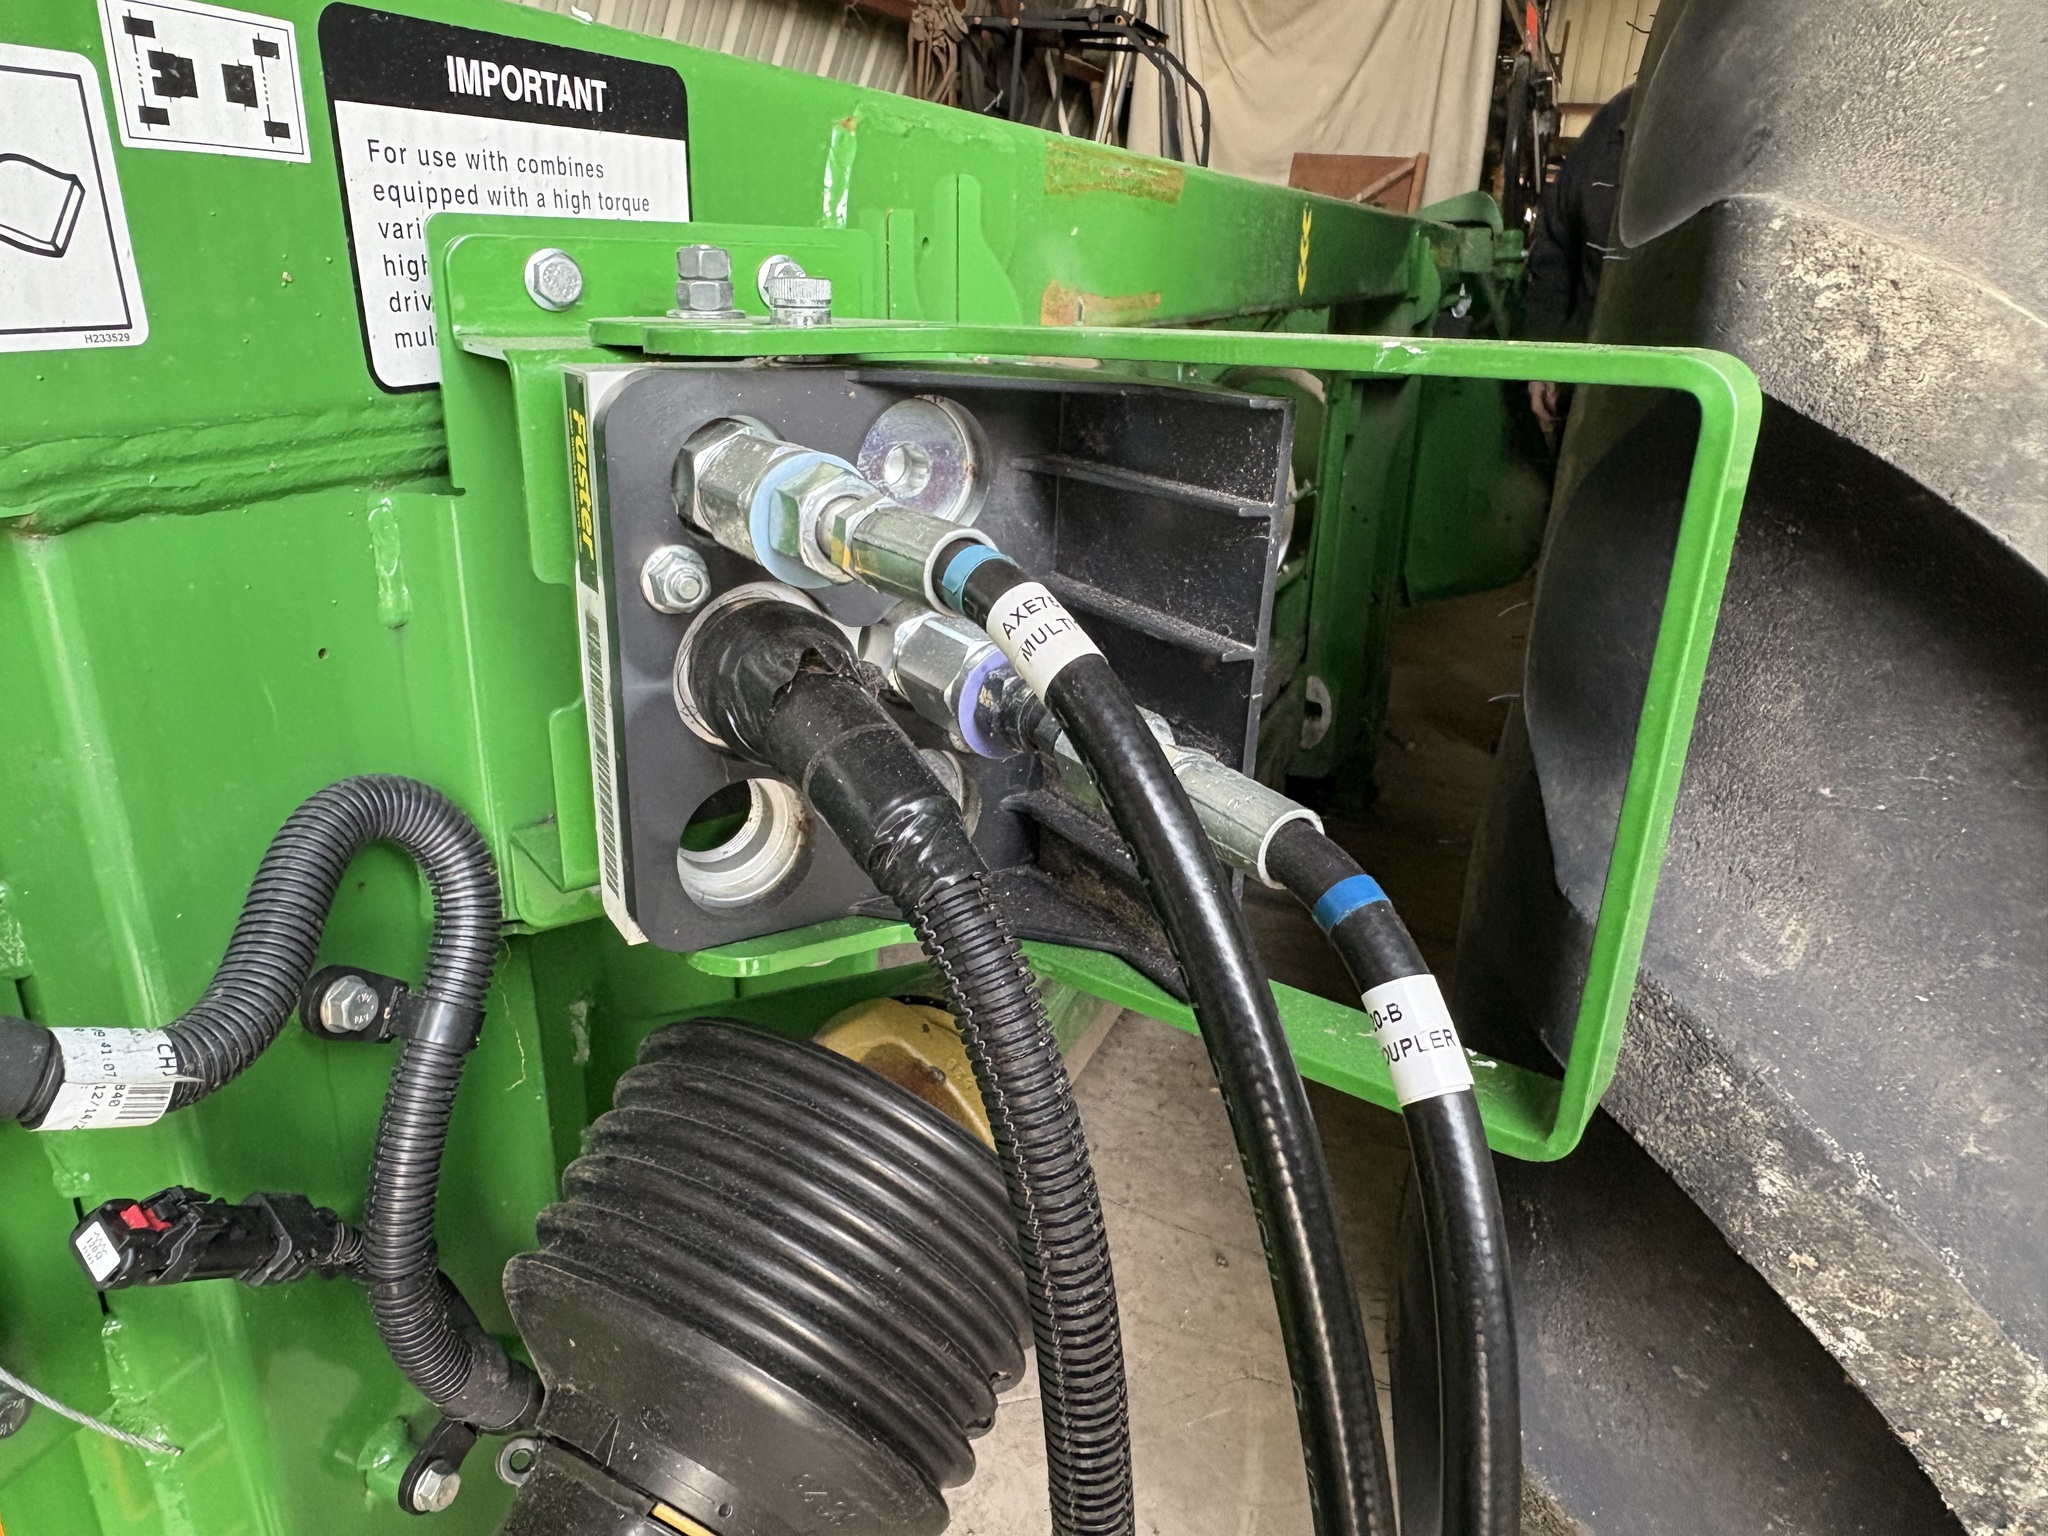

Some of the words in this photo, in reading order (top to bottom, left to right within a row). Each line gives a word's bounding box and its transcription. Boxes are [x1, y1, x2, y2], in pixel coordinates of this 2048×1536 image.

[446, 54, 607, 113] IMPORTANT
[367, 138, 406, 165] For
[418, 149, 456, 168] use
[465, 149, 508, 172] with
[517, 155, 604, 179] combines
[373, 180, 478, 210] equipped
[487, 185, 528, 208] with
[536, 192, 546, 208] a
[553, 188, 591, 214] high
[598, 192, 650, 217] torque
[84, 332, 130, 344] H233529
[572, 408, 594, 561] Faster
